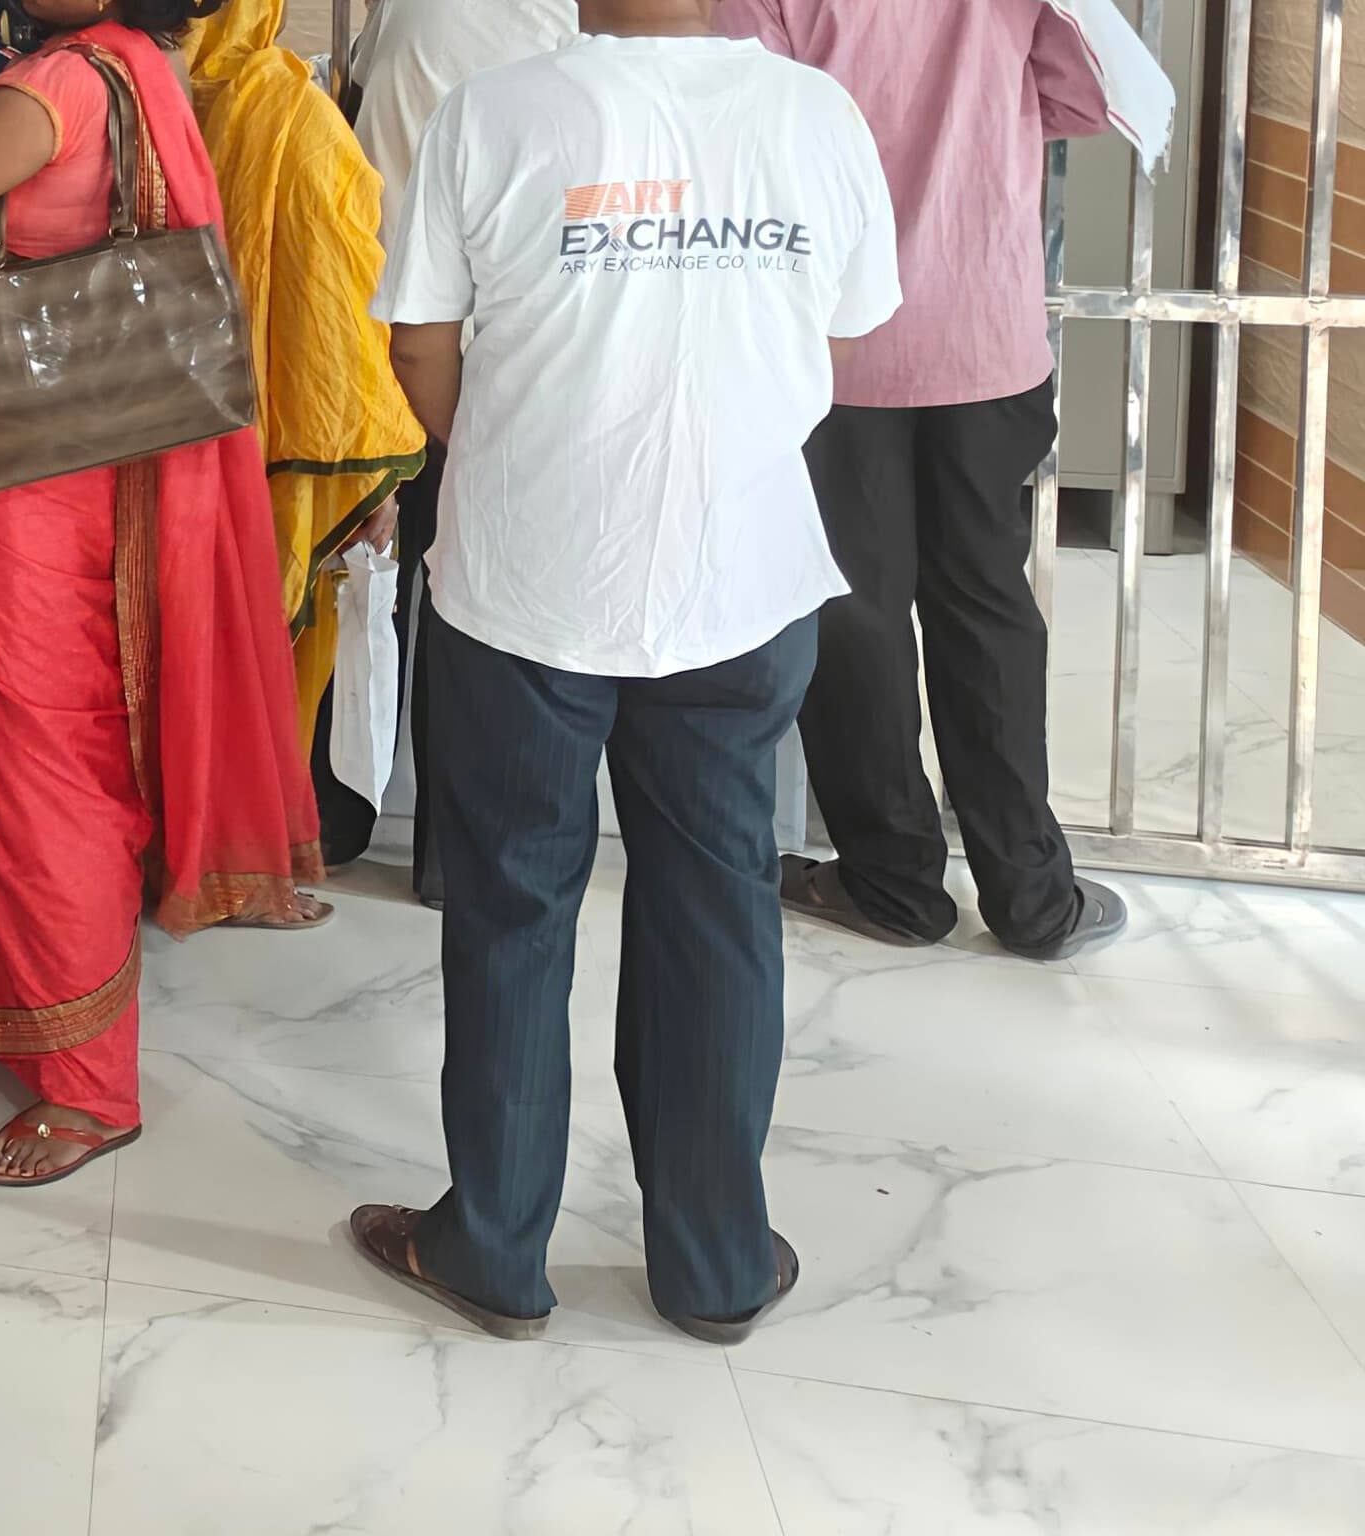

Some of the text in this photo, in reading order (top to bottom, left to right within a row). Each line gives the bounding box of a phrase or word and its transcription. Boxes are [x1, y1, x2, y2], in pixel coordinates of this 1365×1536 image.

[600, 179, 692, 216] ARY
[559, 217, 812, 256] EXCHANGE
[559, 259, 598, 275] ARY
[603, 255, 710, 272] EXCHANGE
